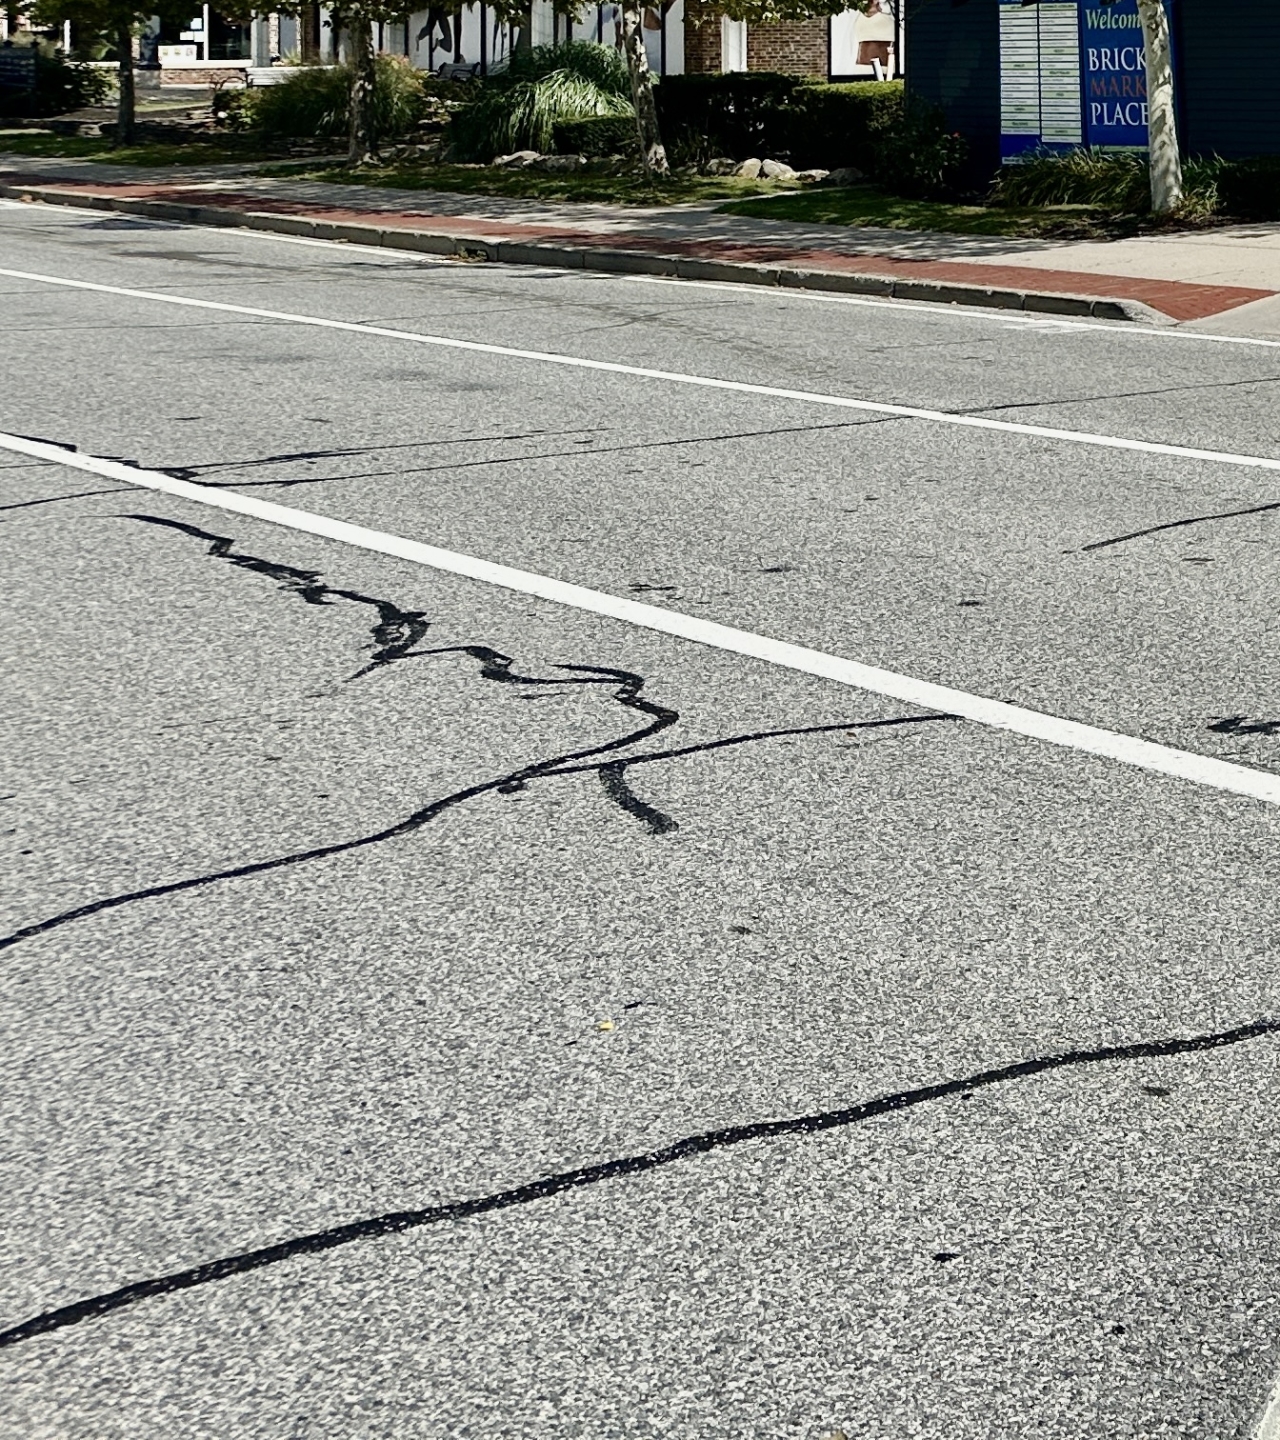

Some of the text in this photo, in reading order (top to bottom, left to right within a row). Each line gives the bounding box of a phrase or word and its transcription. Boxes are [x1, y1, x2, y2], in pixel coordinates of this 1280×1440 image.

[1085, 7, 1142, 31] Welcom
[1087, 46, 1148, 72] BRICK
[1090, 75, 1148, 98] MARK
